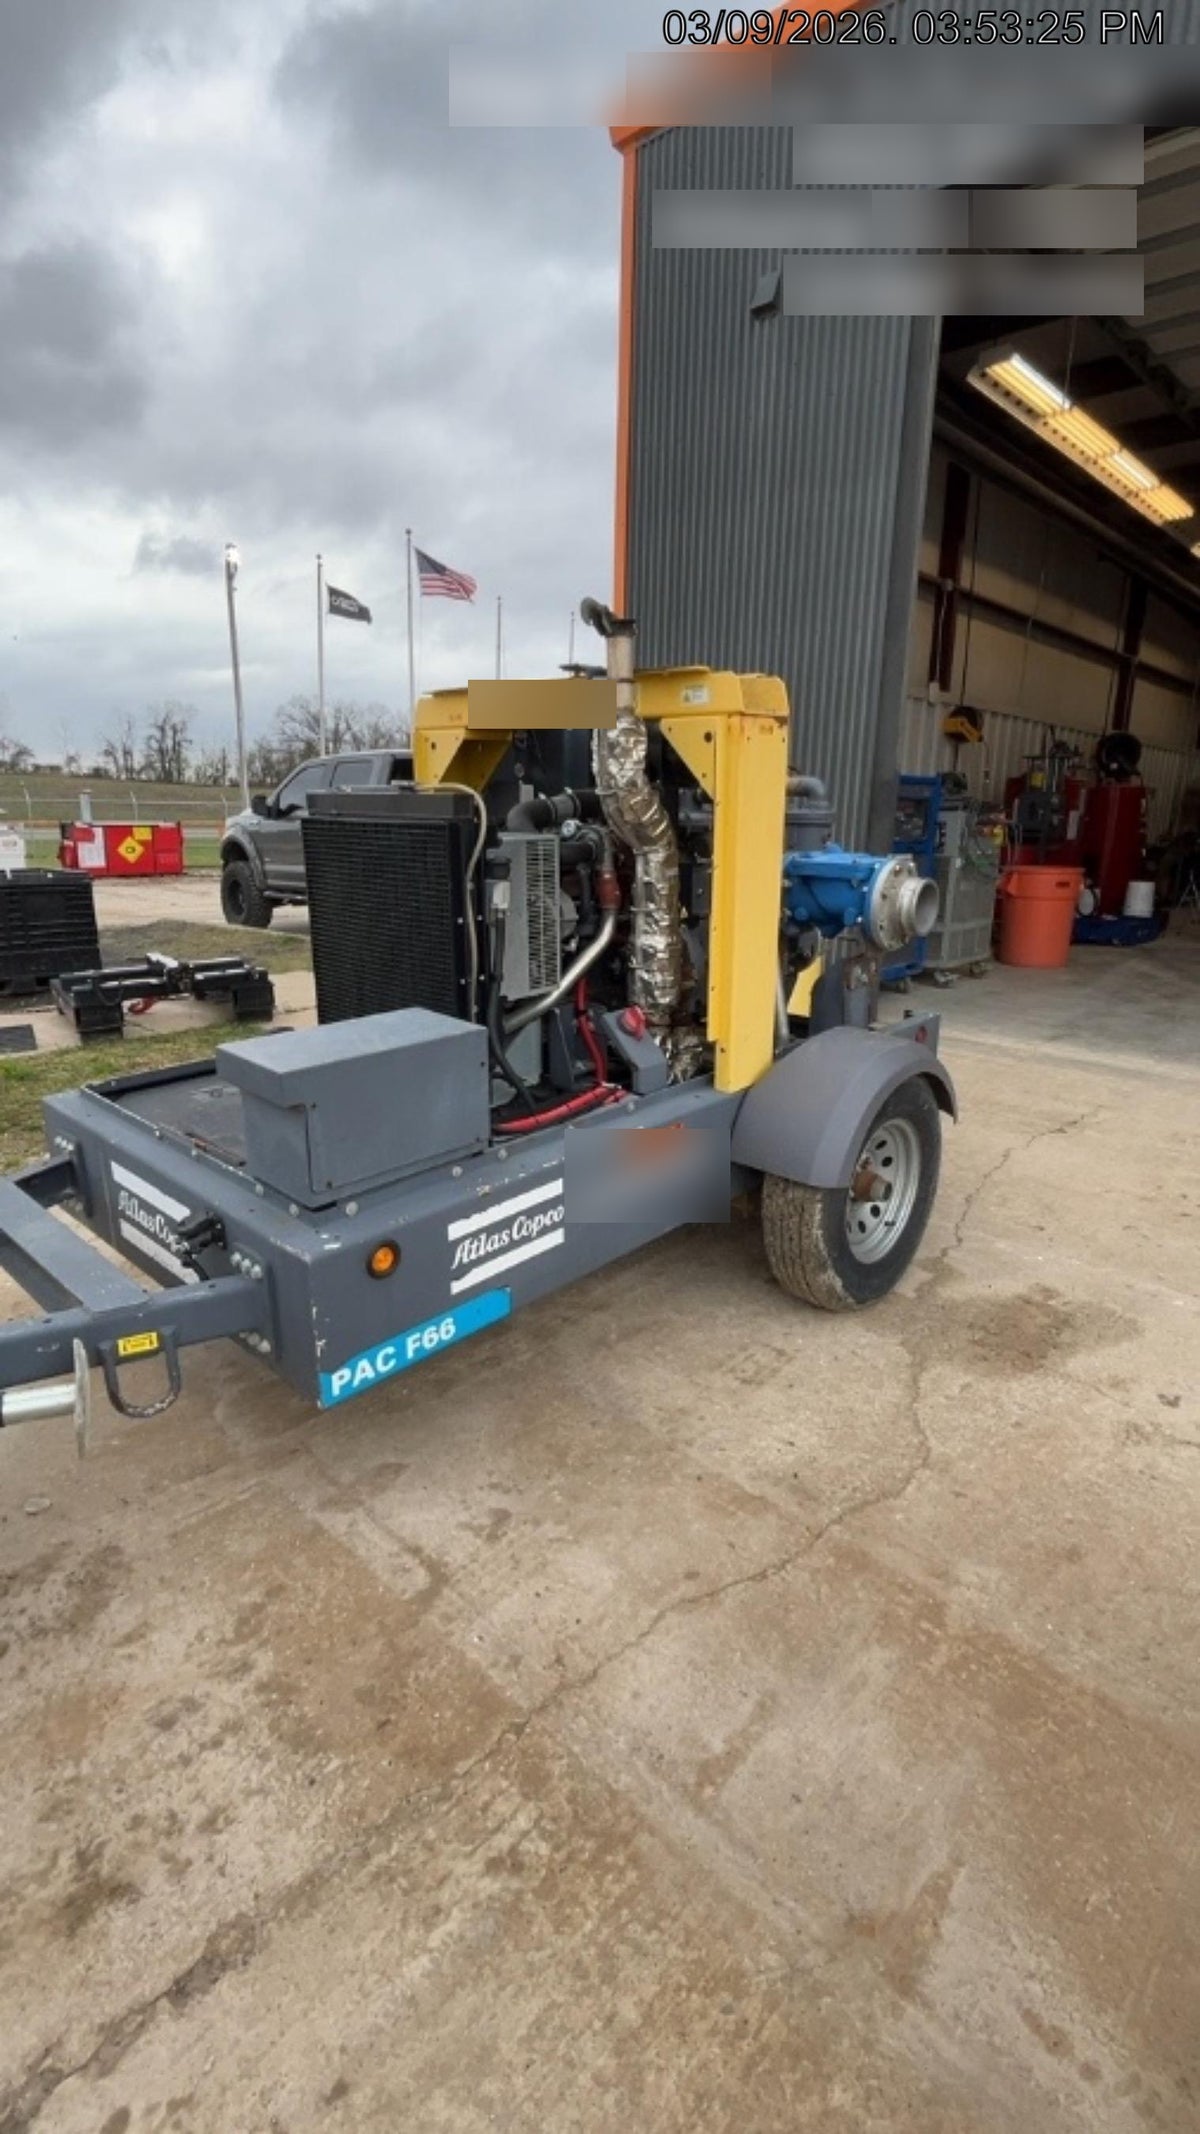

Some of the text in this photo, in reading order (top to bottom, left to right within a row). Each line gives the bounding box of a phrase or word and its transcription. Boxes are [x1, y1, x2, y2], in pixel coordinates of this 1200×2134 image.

[118, 1189, 155, 1233] Atlas
[450, 1204, 565, 1270] Atlas Copco
[330, 1317, 457, 1397] PAC F66
